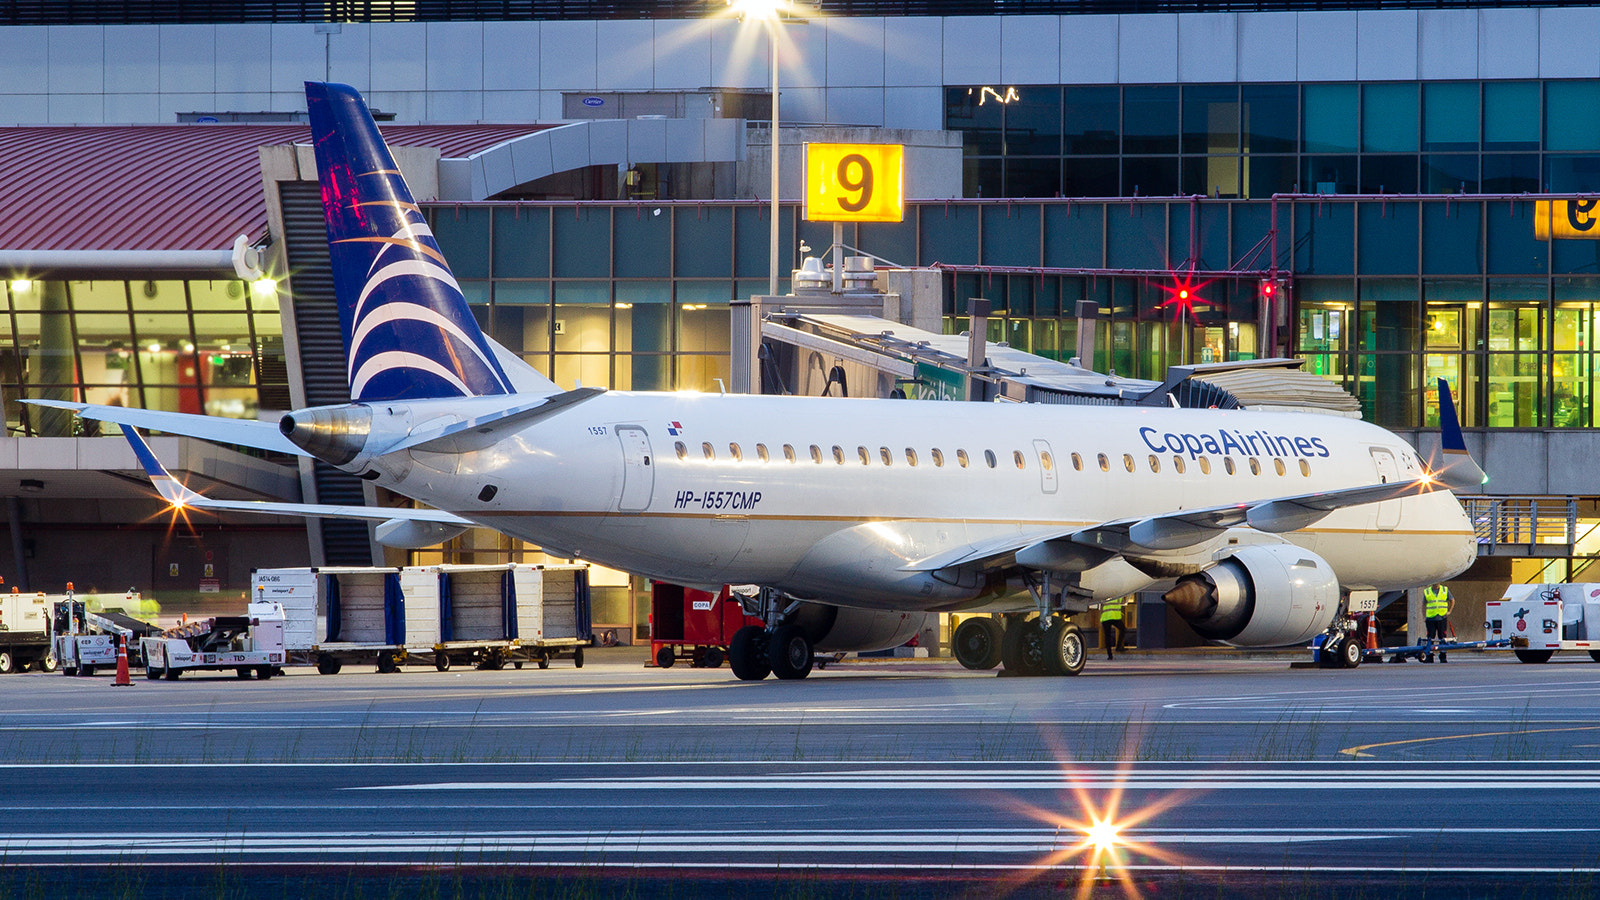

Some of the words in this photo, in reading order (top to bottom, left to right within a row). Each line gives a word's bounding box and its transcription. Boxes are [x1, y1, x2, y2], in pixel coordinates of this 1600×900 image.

[836, 153, 874, 212] 9
[587, 426, 608, 436] 1557
[1138, 426, 1330, 461] CopaAirlines
[674, 490, 762, 510] HP-1557CMP
[1360, 599, 1376, 609] 1557
